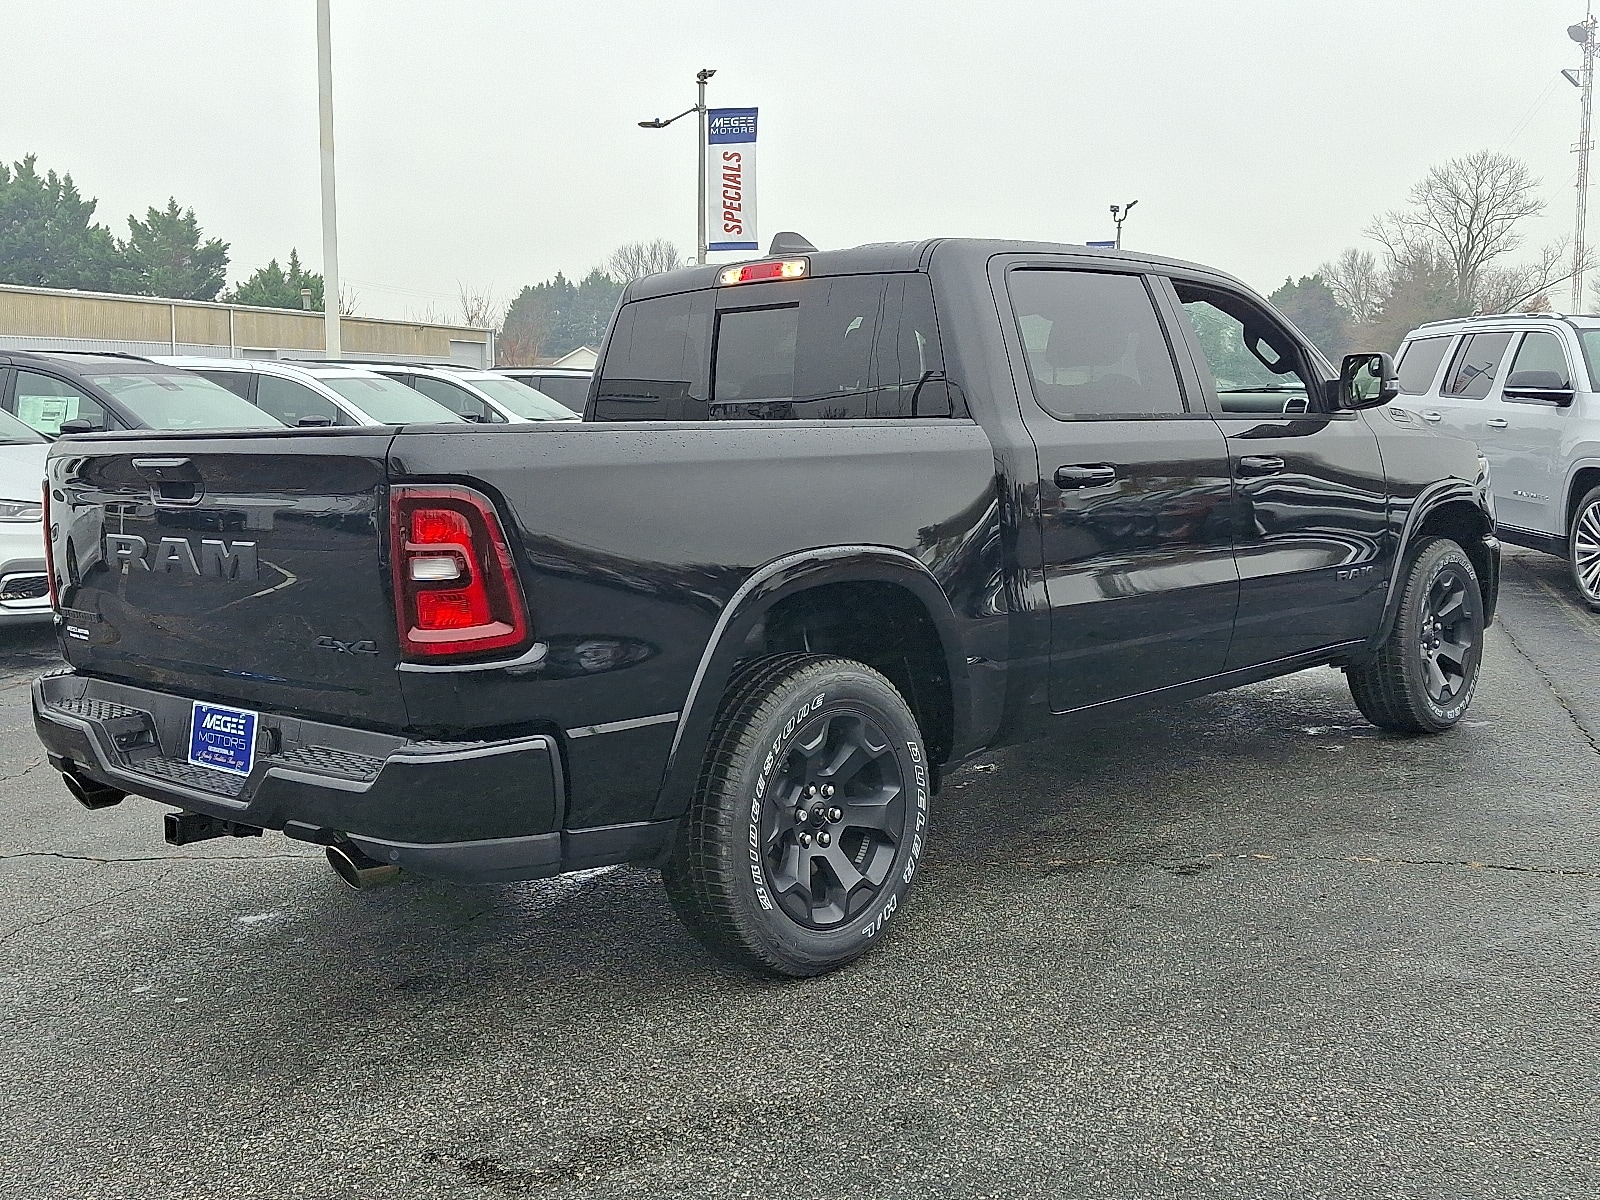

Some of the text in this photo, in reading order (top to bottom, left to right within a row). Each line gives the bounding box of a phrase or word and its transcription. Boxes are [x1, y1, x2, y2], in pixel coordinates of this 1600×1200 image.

[710, 116, 755, 127] MEGEE
[710, 126, 755, 134] MOTORS
[722, 151, 743, 235] SPECIALS
[105, 533, 260, 580] RAM
[198, 731, 247, 750] MOTORS
[202, 713, 247, 736] MEGEE
[749, 693, 826, 911] BRIDGESTONE
[862, 741, 926, 938] DUELER H/L
